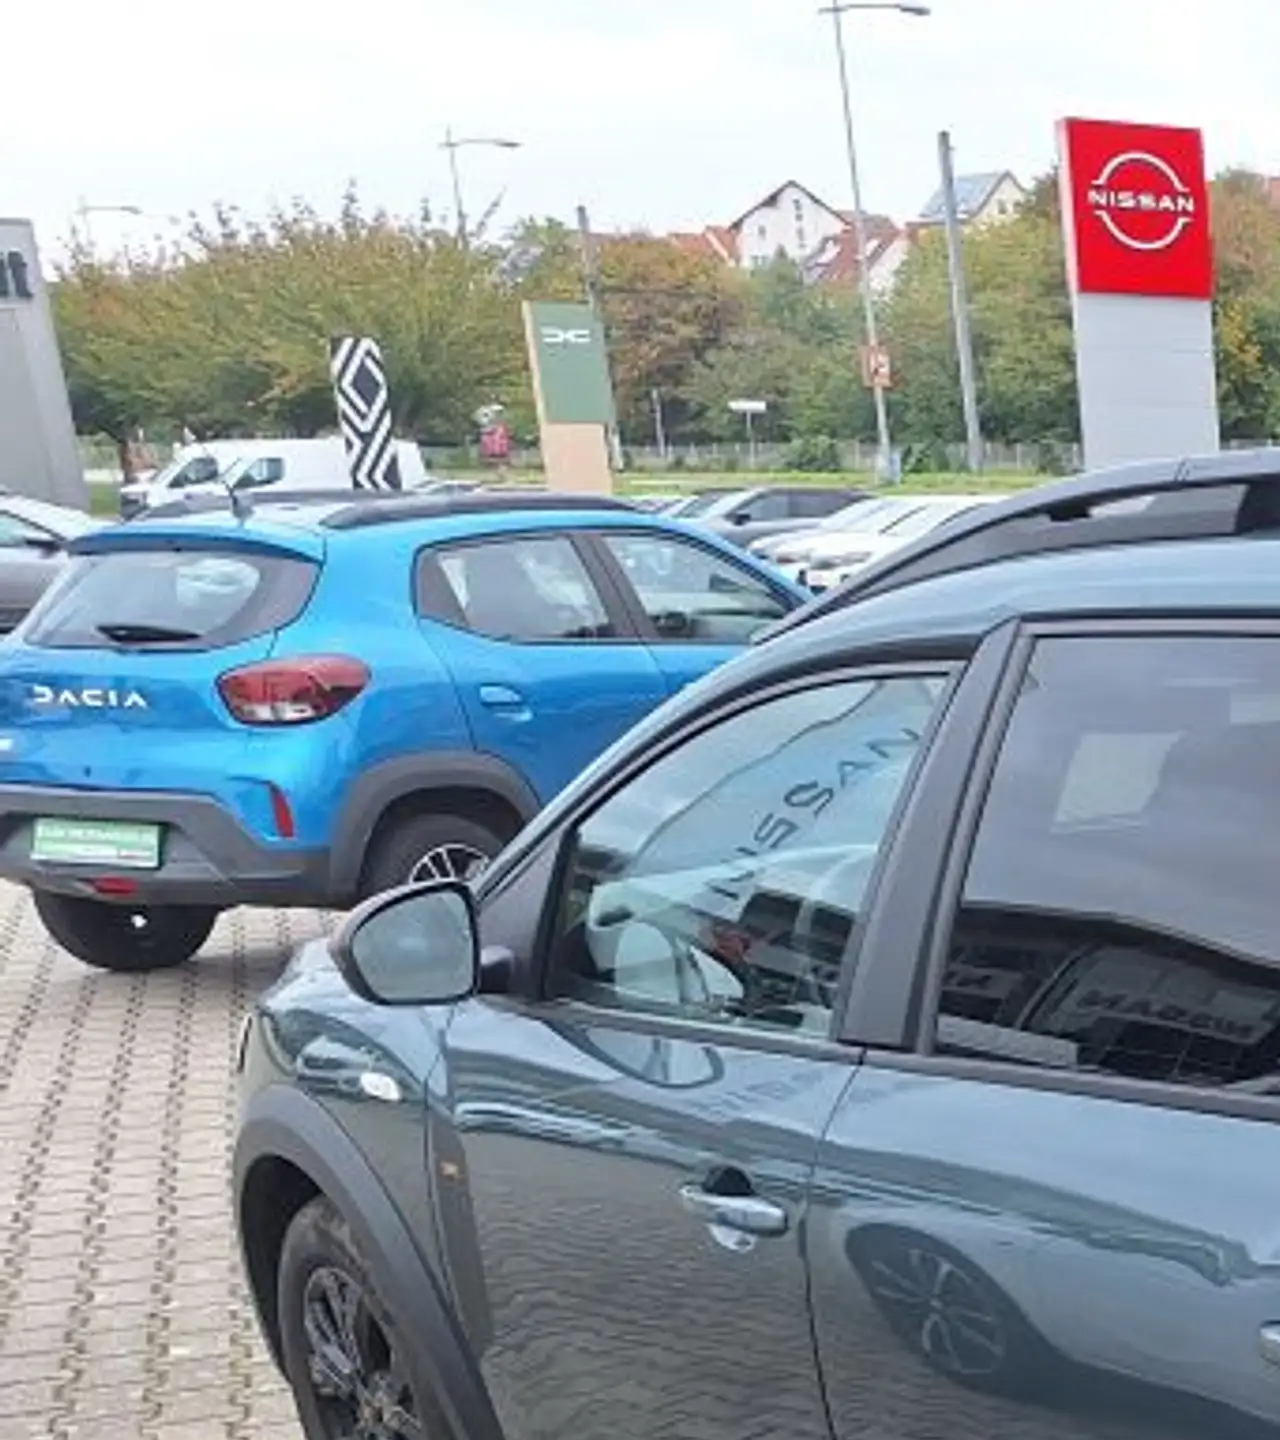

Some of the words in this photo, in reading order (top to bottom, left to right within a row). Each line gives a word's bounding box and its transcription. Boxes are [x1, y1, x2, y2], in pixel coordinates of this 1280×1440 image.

[1087, 190, 1194, 212] NISSAN
[33, 685, 148, 708] DACIA
[708, 728, 920, 902] NISSAN
